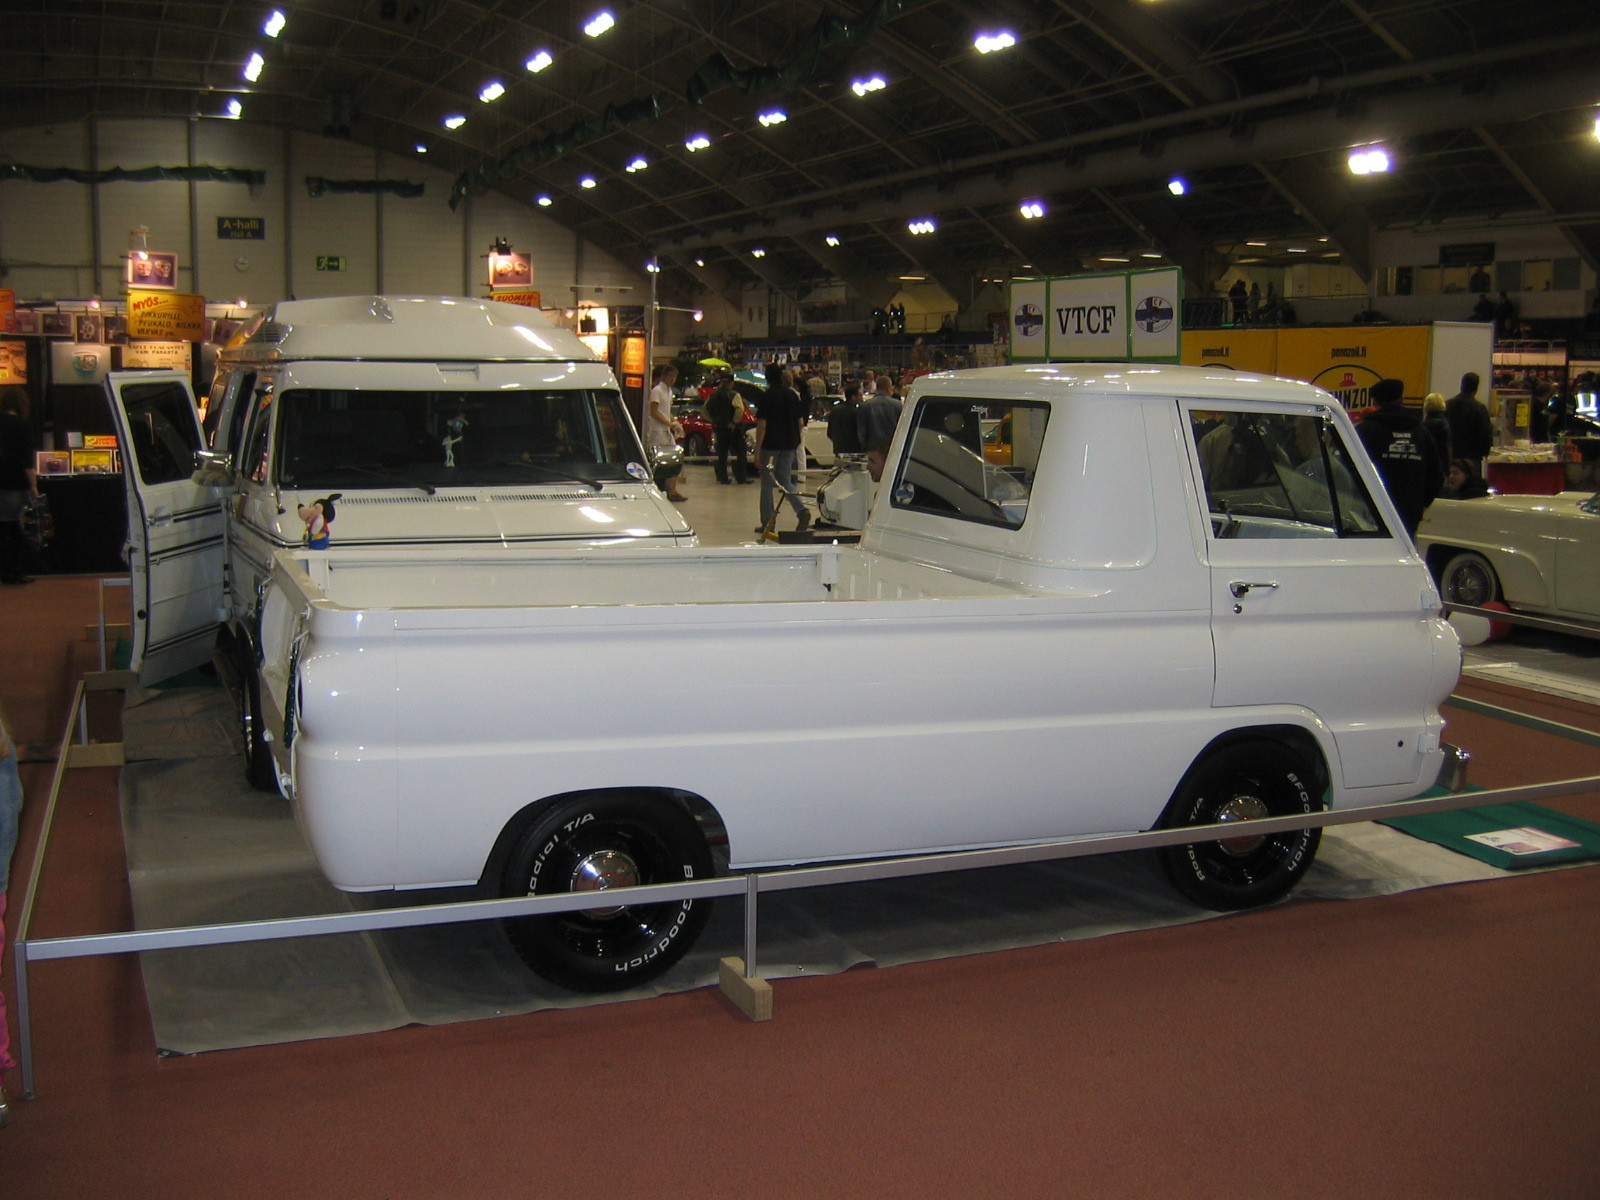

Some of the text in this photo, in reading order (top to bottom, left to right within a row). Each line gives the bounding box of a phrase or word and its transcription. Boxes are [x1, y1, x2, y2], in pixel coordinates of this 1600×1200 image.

[223, 219, 260, 230] A-halli
[1056, 305, 1116, 335] VTCF
[563, 812, 595, 832] T/A
[615, 864, 694, 972] BGoodrich
